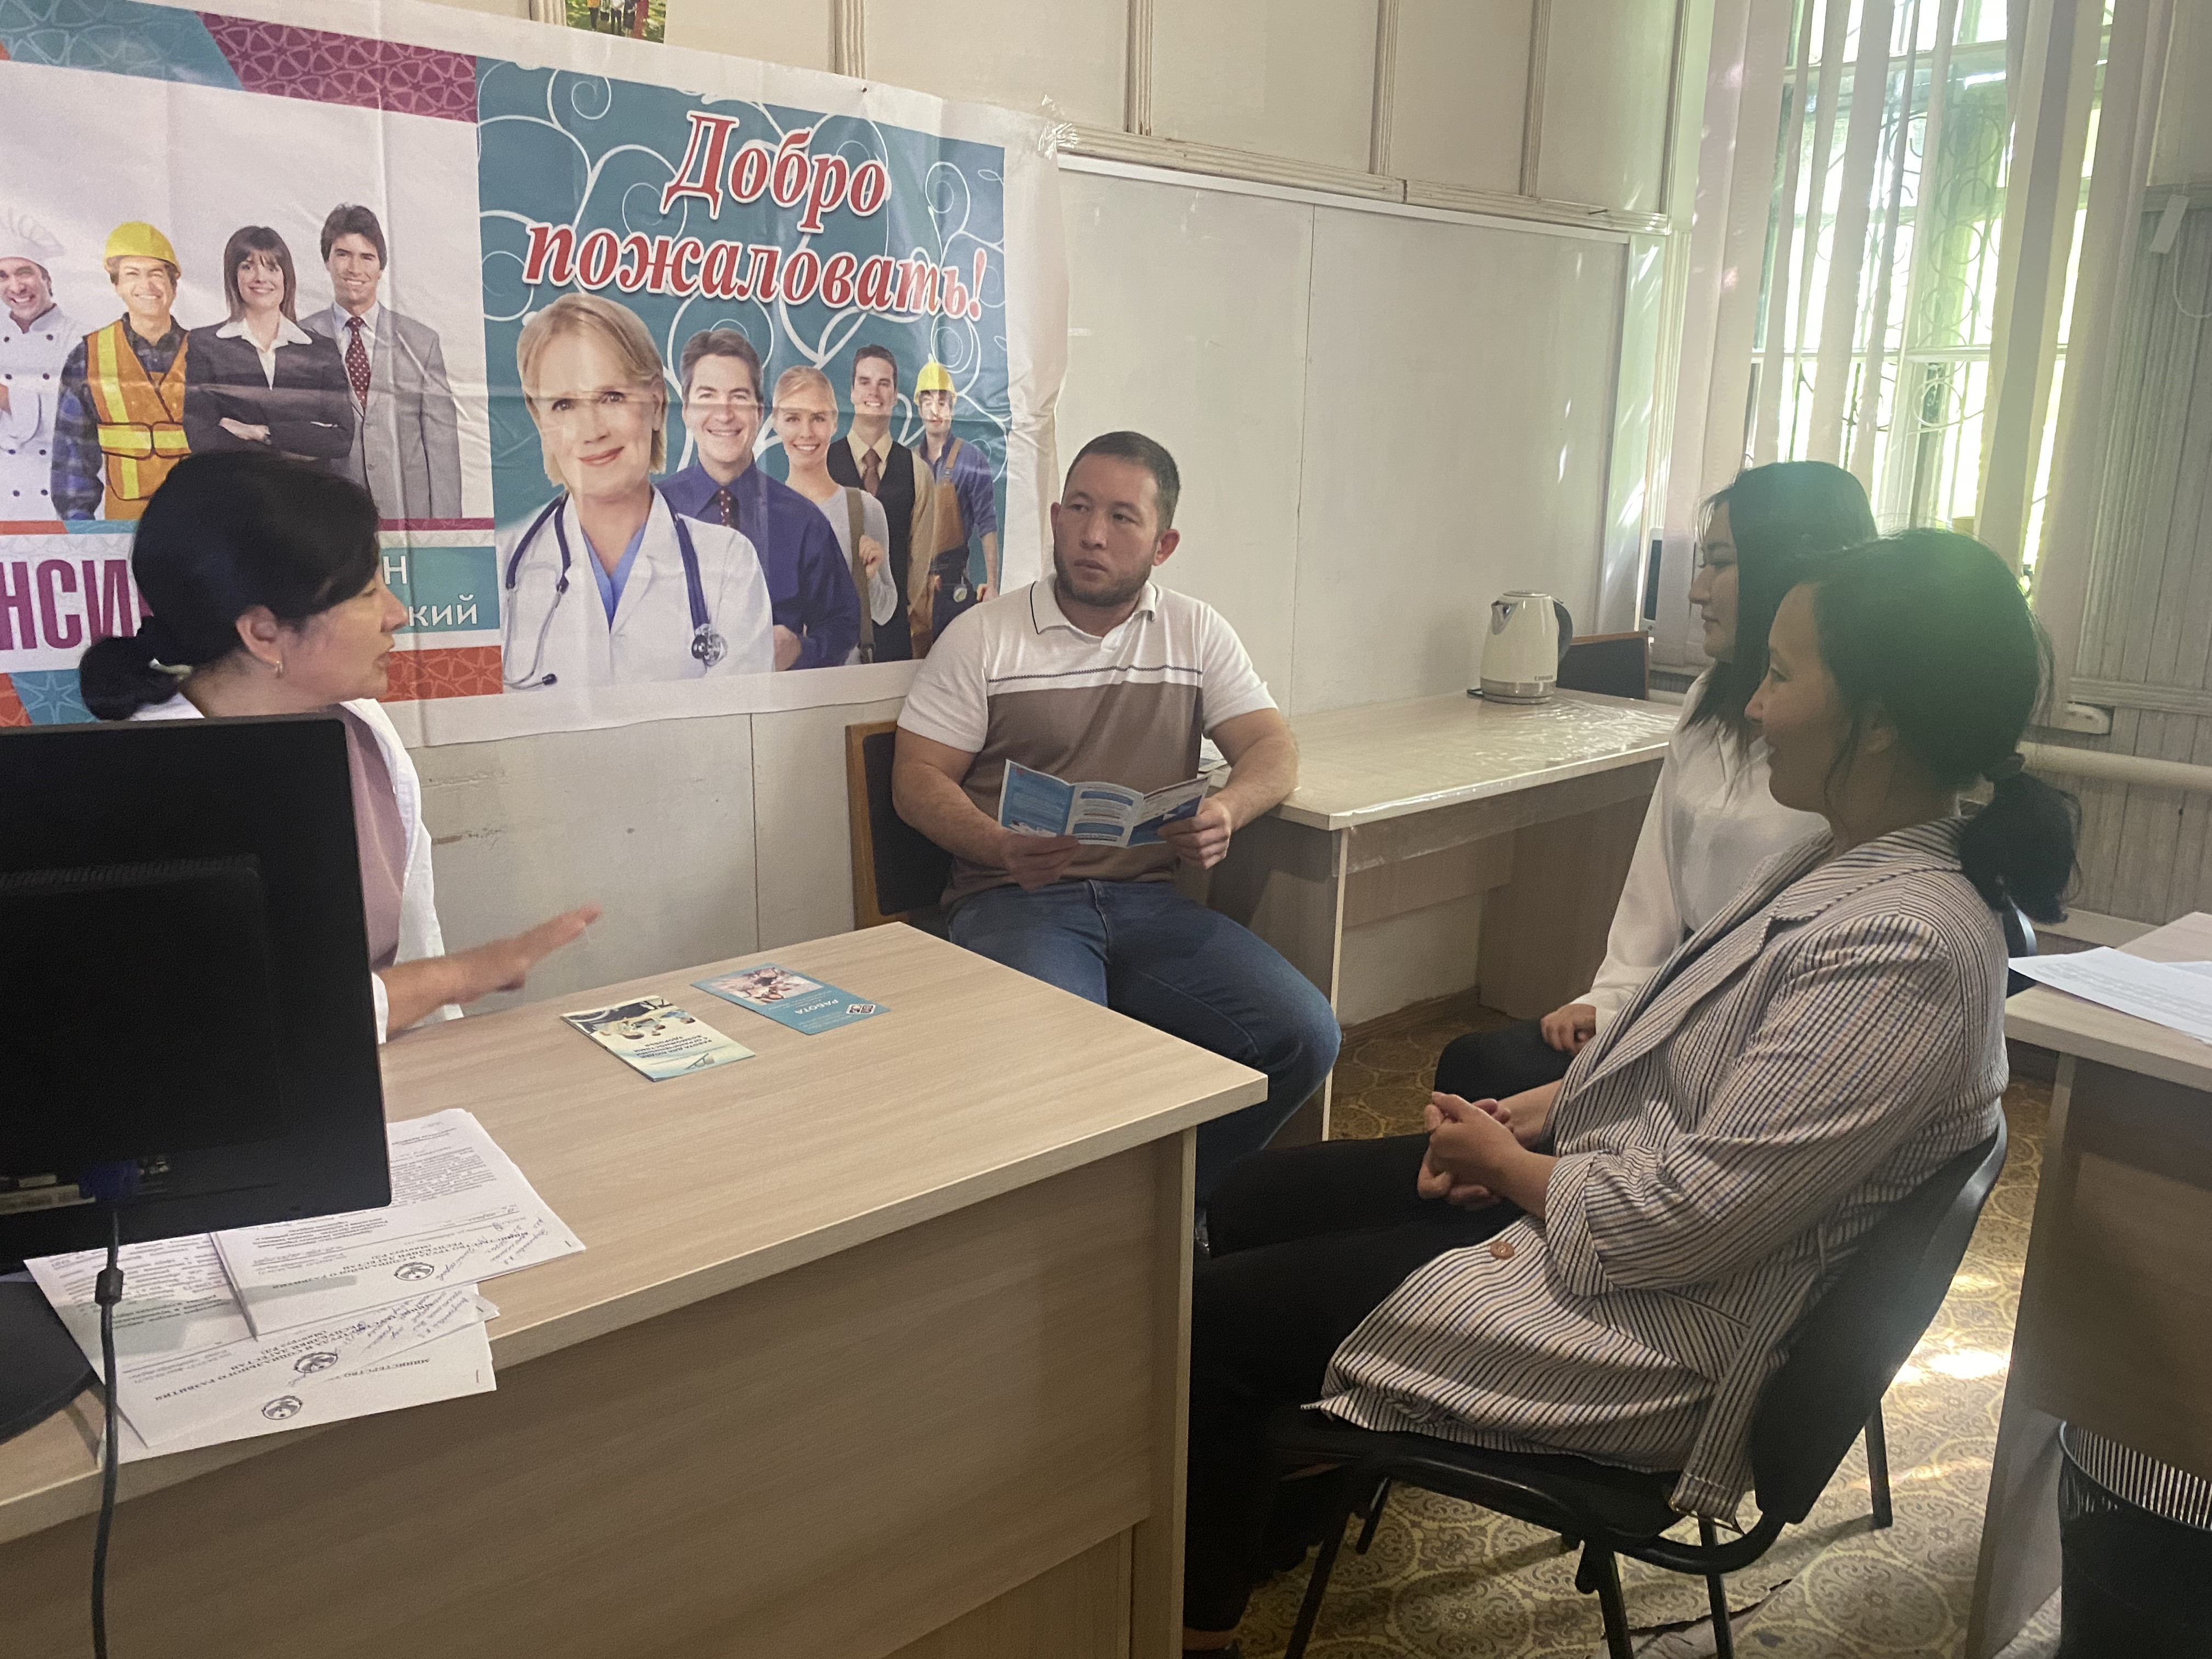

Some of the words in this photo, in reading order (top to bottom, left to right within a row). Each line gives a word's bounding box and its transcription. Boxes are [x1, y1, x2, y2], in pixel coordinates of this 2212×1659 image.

[660, 111, 889, 233] Добро
[522, 221, 988, 323] пожаловать!
[0, 559, 153, 650] НСИ
[795, 999, 839, 1014] РАБОТА
[344, 1358, 431, 1378] МИНИСТЕРСТВО
